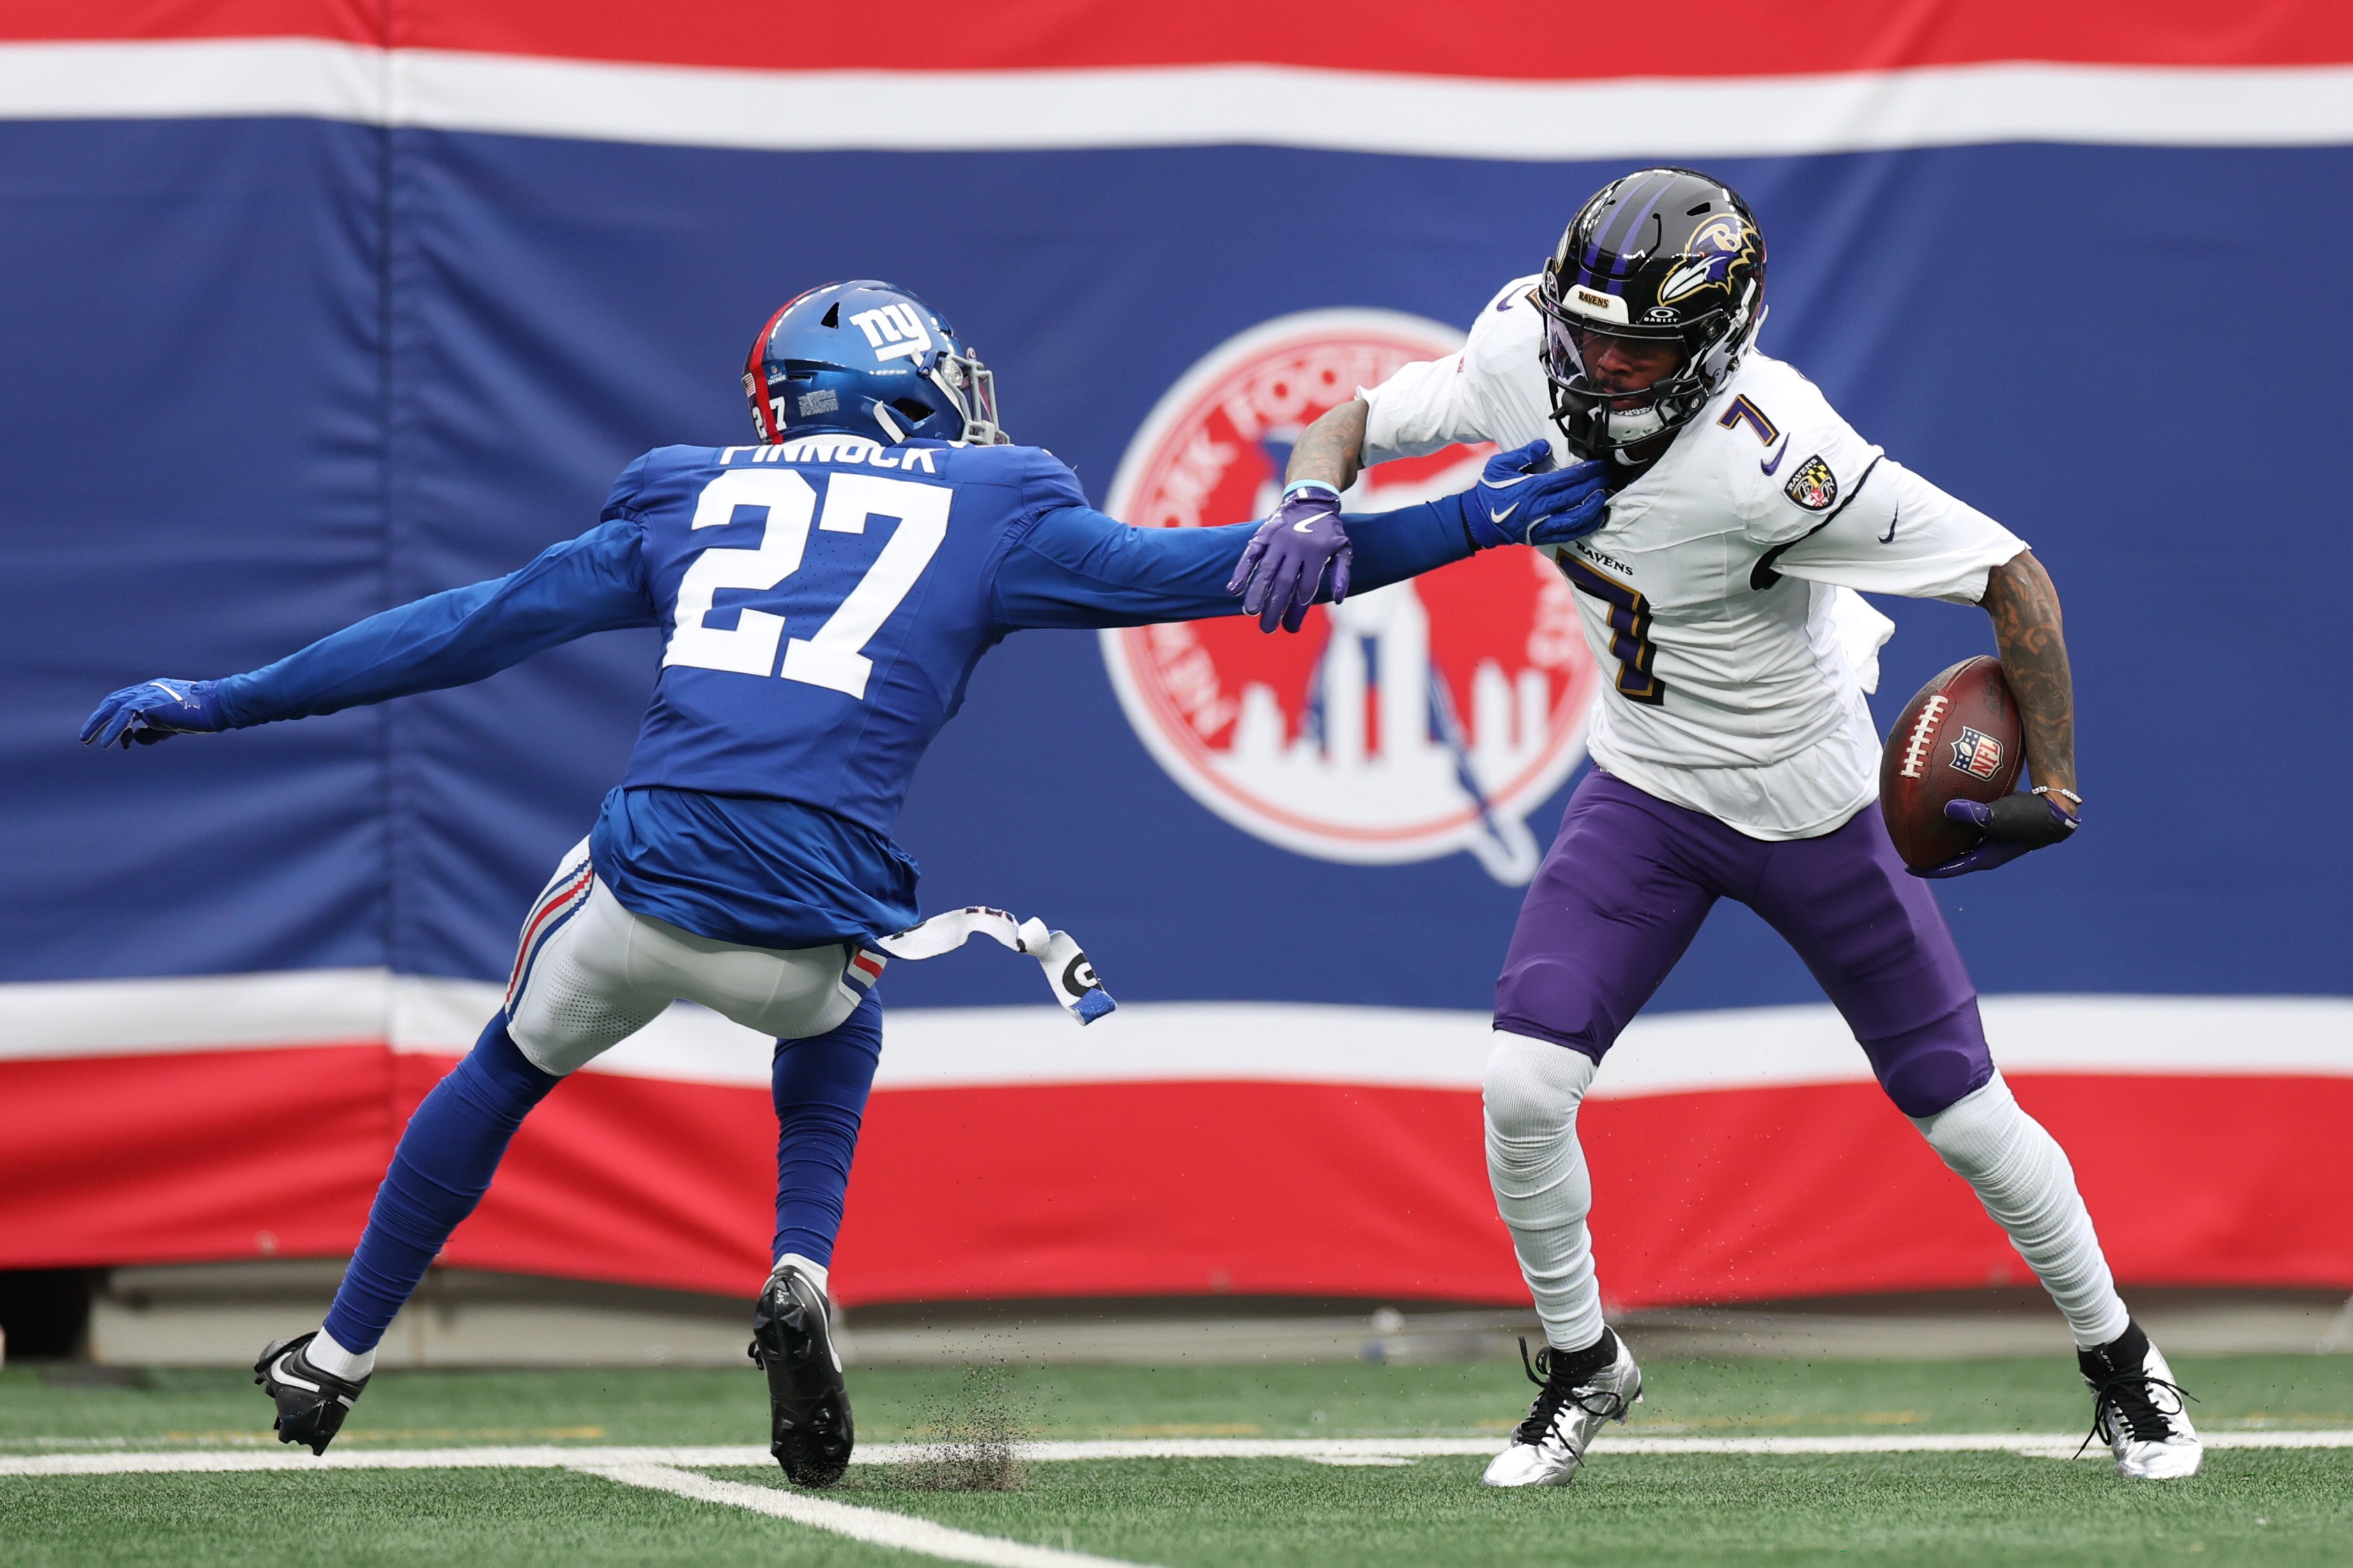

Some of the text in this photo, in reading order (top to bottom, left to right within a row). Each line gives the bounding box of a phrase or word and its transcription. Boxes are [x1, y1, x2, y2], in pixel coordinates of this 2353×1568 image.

[1579, 291, 1610, 308] RAVENS
[1717, 394, 1780, 446] 7
[719, 445, 947, 474] PINNOCK
[1786, 458, 1818, 491] RAVENS
[1575, 540, 1634, 575] RAVENS
[663, 469, 953, 700] 27
[1556, 547, 1666, 706] 7
[1970, 742, 1999, 776] NFL
